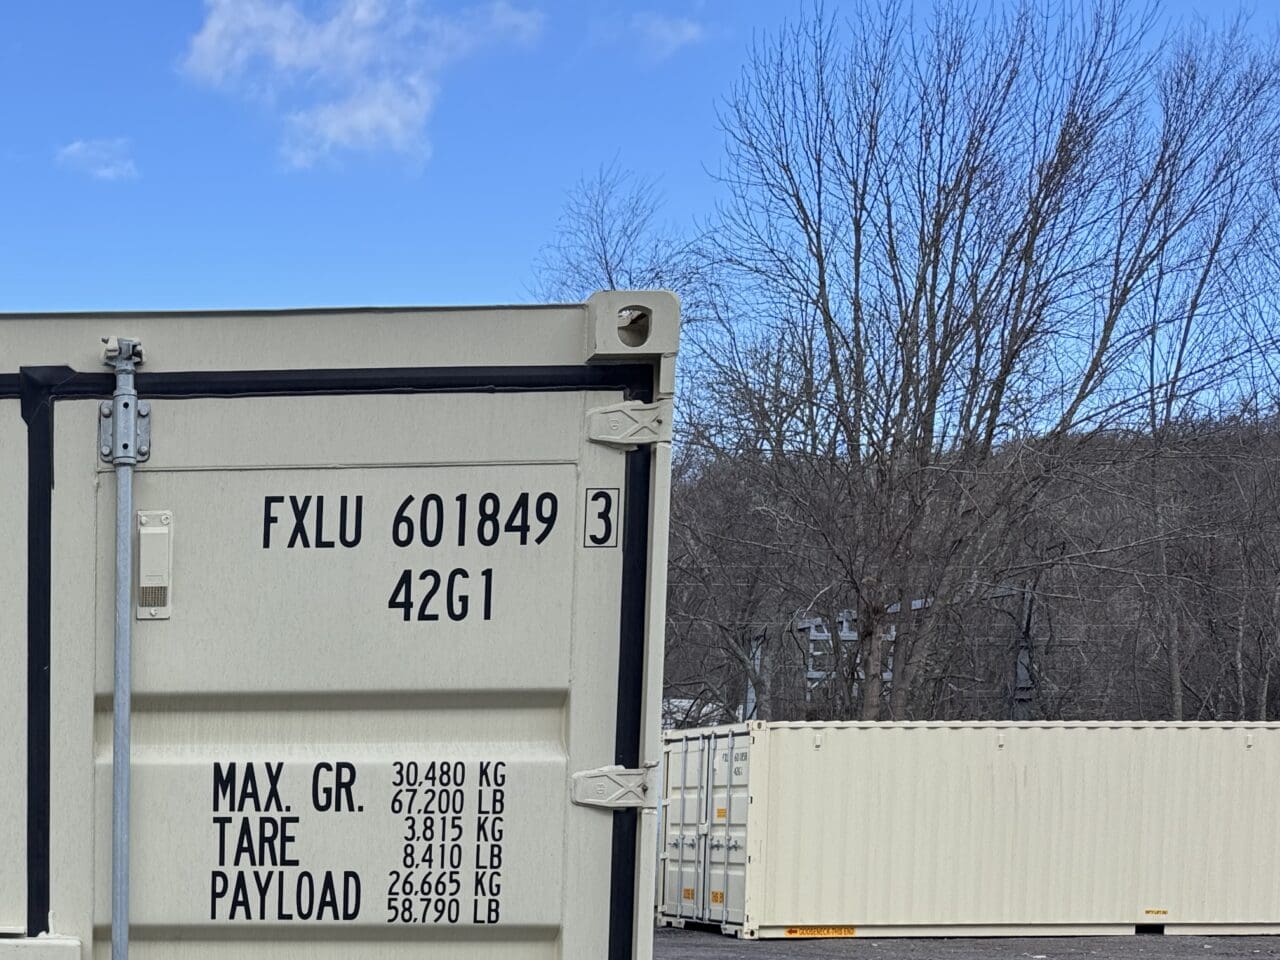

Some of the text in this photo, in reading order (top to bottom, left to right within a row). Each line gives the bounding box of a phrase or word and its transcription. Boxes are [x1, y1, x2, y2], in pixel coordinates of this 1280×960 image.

[263, 491, 613, 548] FXLU 601849 3
[388, 568, 493, 621] 42G1
[212, 761, 507, 812] MAX. GR. 30,480 KG
[391, 789, 505, 815] 67,200 LB
[213, 816, 504, 866] TARE 3,815 KG
[403, 844, 503, 870] 8,410 LB
[210, 870, 501, 921] PAYLOAD 26,665 KG
[387, 898, 500, 924] 58,790 LB
